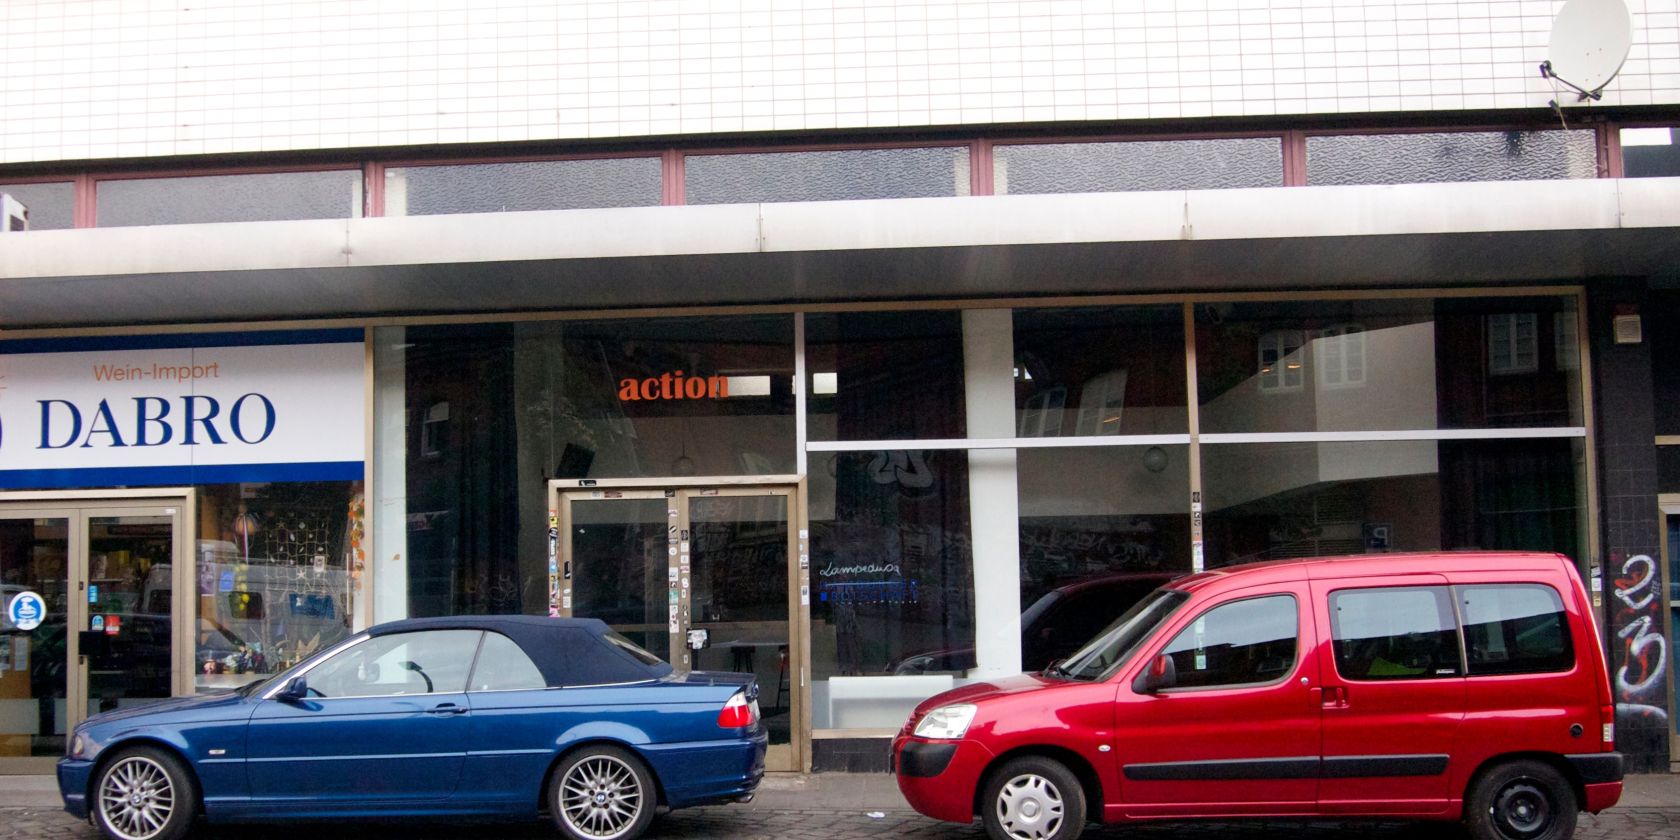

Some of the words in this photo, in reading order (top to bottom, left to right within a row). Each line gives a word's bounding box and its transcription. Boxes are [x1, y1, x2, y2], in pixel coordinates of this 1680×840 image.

[94, 361, 219, 383] Wein-Import
[619, 370, 729, 401] action
[36, 392, 276, 449] DABRO
